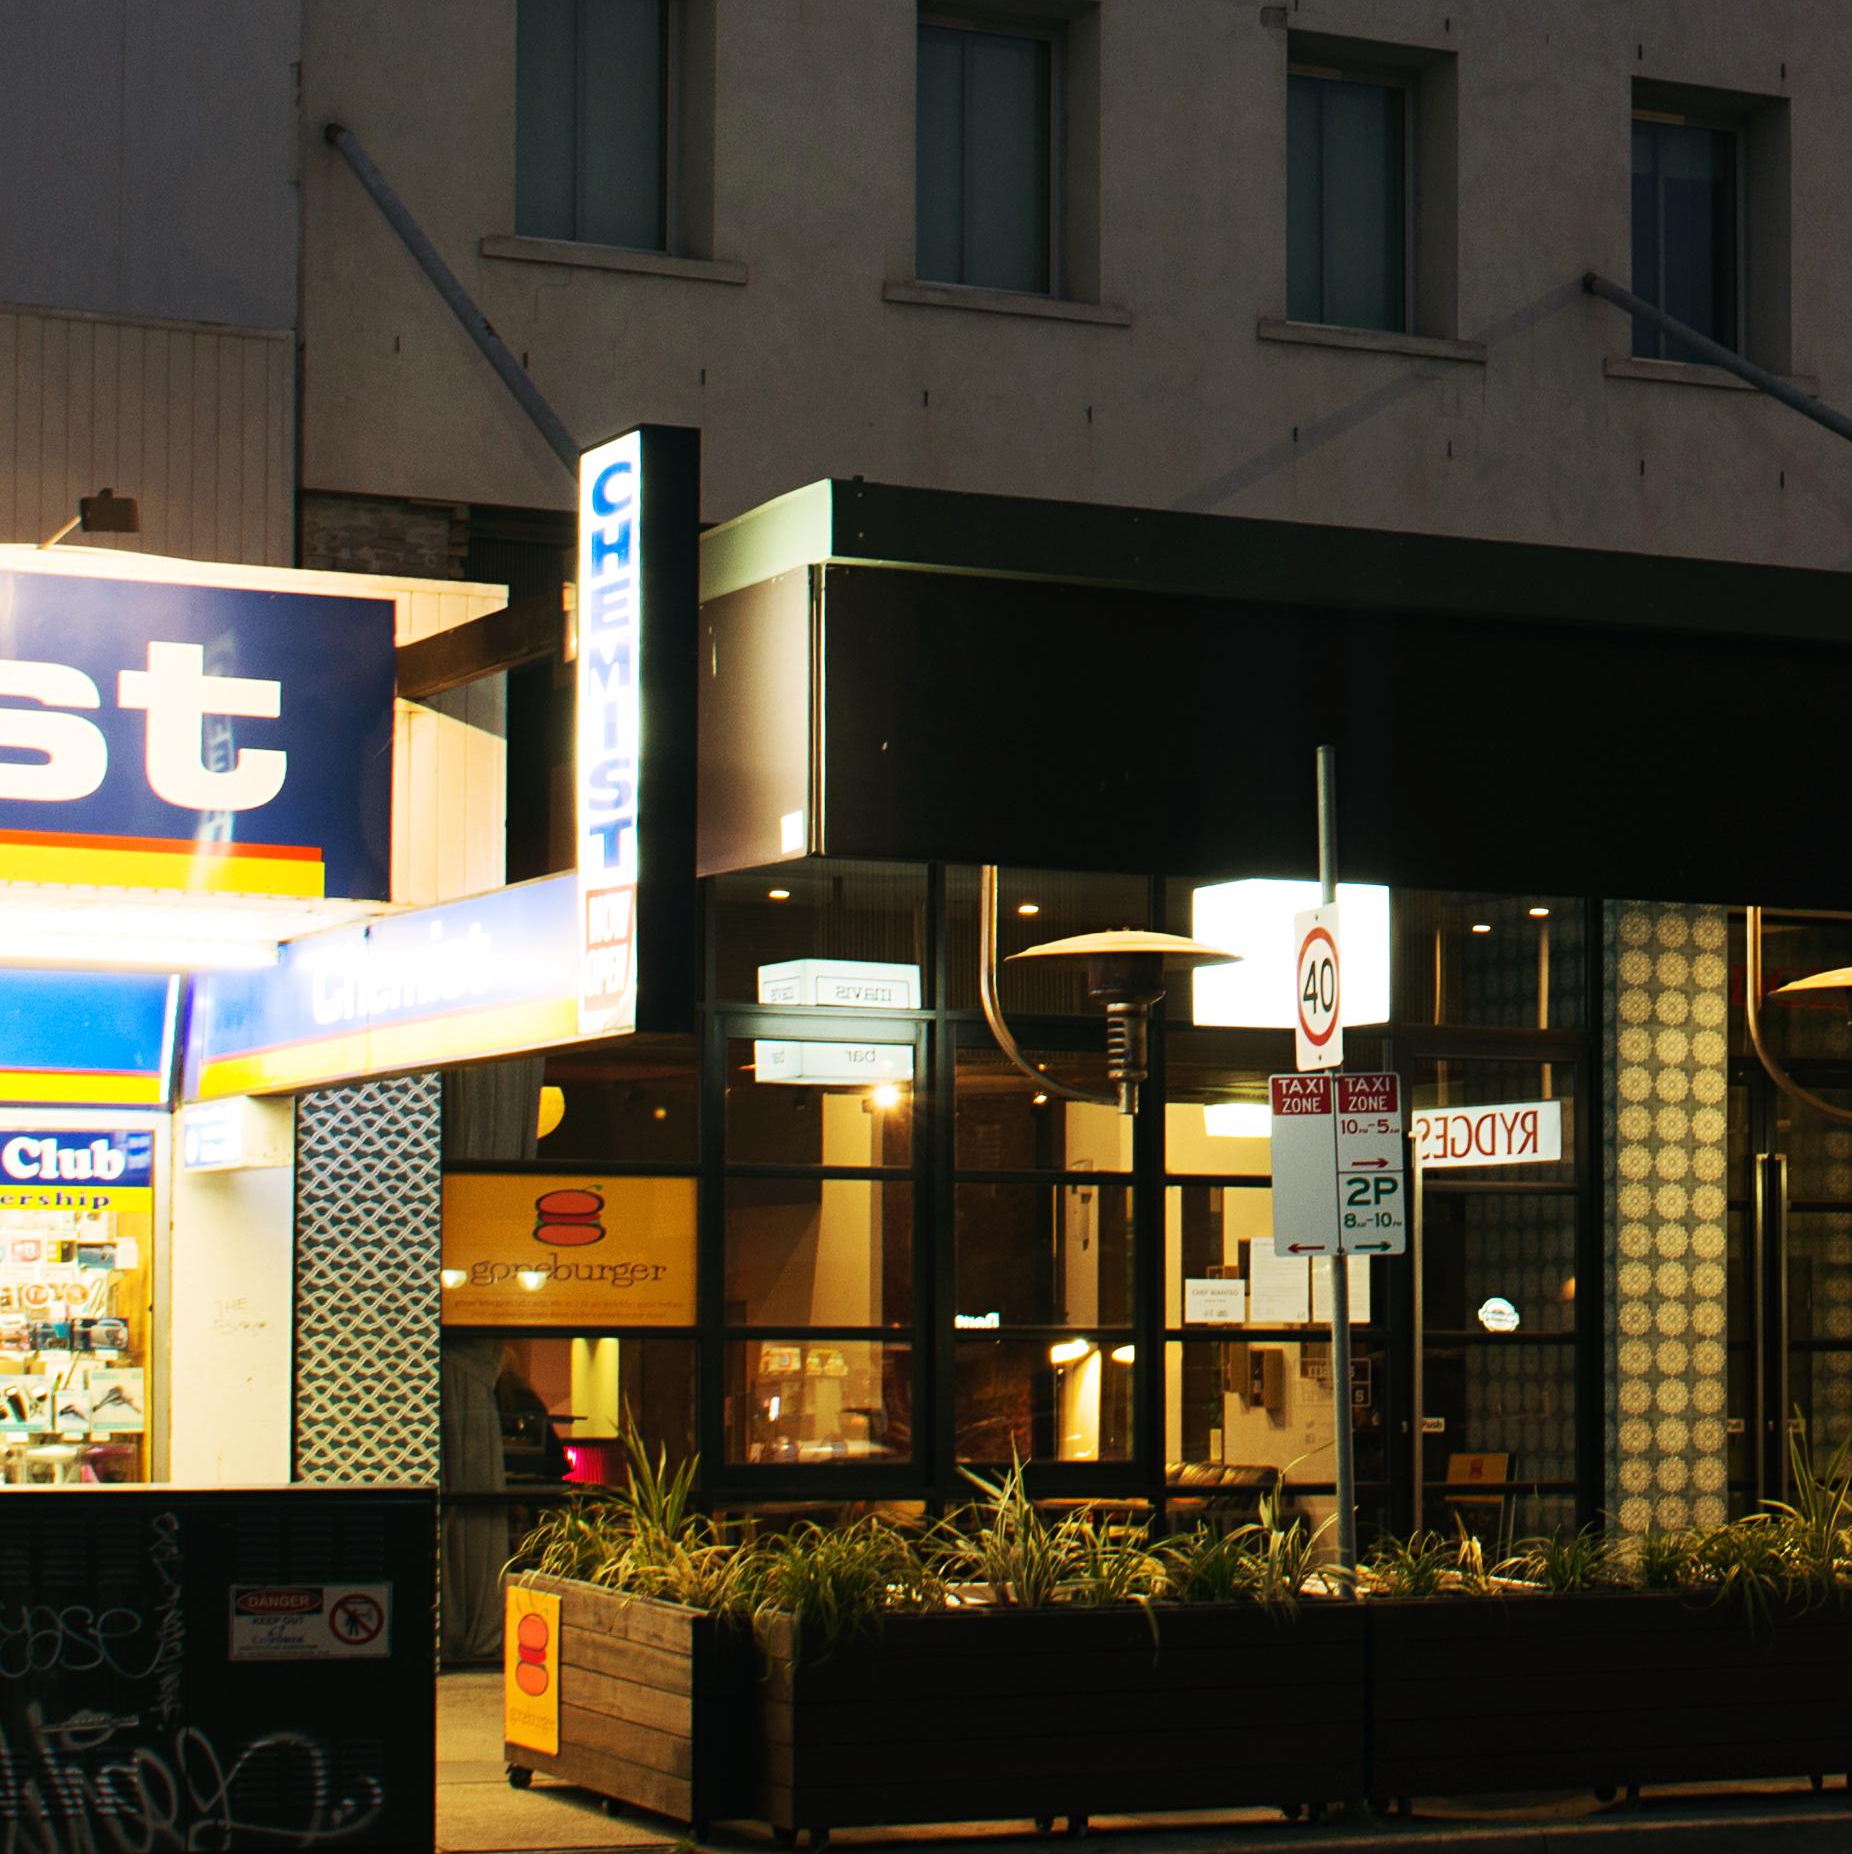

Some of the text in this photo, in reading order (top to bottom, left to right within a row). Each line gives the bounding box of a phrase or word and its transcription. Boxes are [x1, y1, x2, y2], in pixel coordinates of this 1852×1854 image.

[587, 459, 634, 869] CHEMIST
[0, 640, 288, 812] st
[310, 919, 493, 1026] Chemist
[1303, 957, 1335, 1015] 40
[1278, 1078, 1324, 1095] TAXI
[1344, 1077, 1390, 1093] TAXI
[1282, 1097, 1322, 1114] ZONE
[1348, 1096, 1387, 1112] ZONE
[1, 1135, 127, 1181] Club
[0, 1191, 111, 1210] ership
[1346, 1176, 1399, 1207] 2P
[470, 1252, 667, 1289] goneburger
[248, 1595, 310, 1608] DANGER
[283, 1617, 304, 1626] OUT
